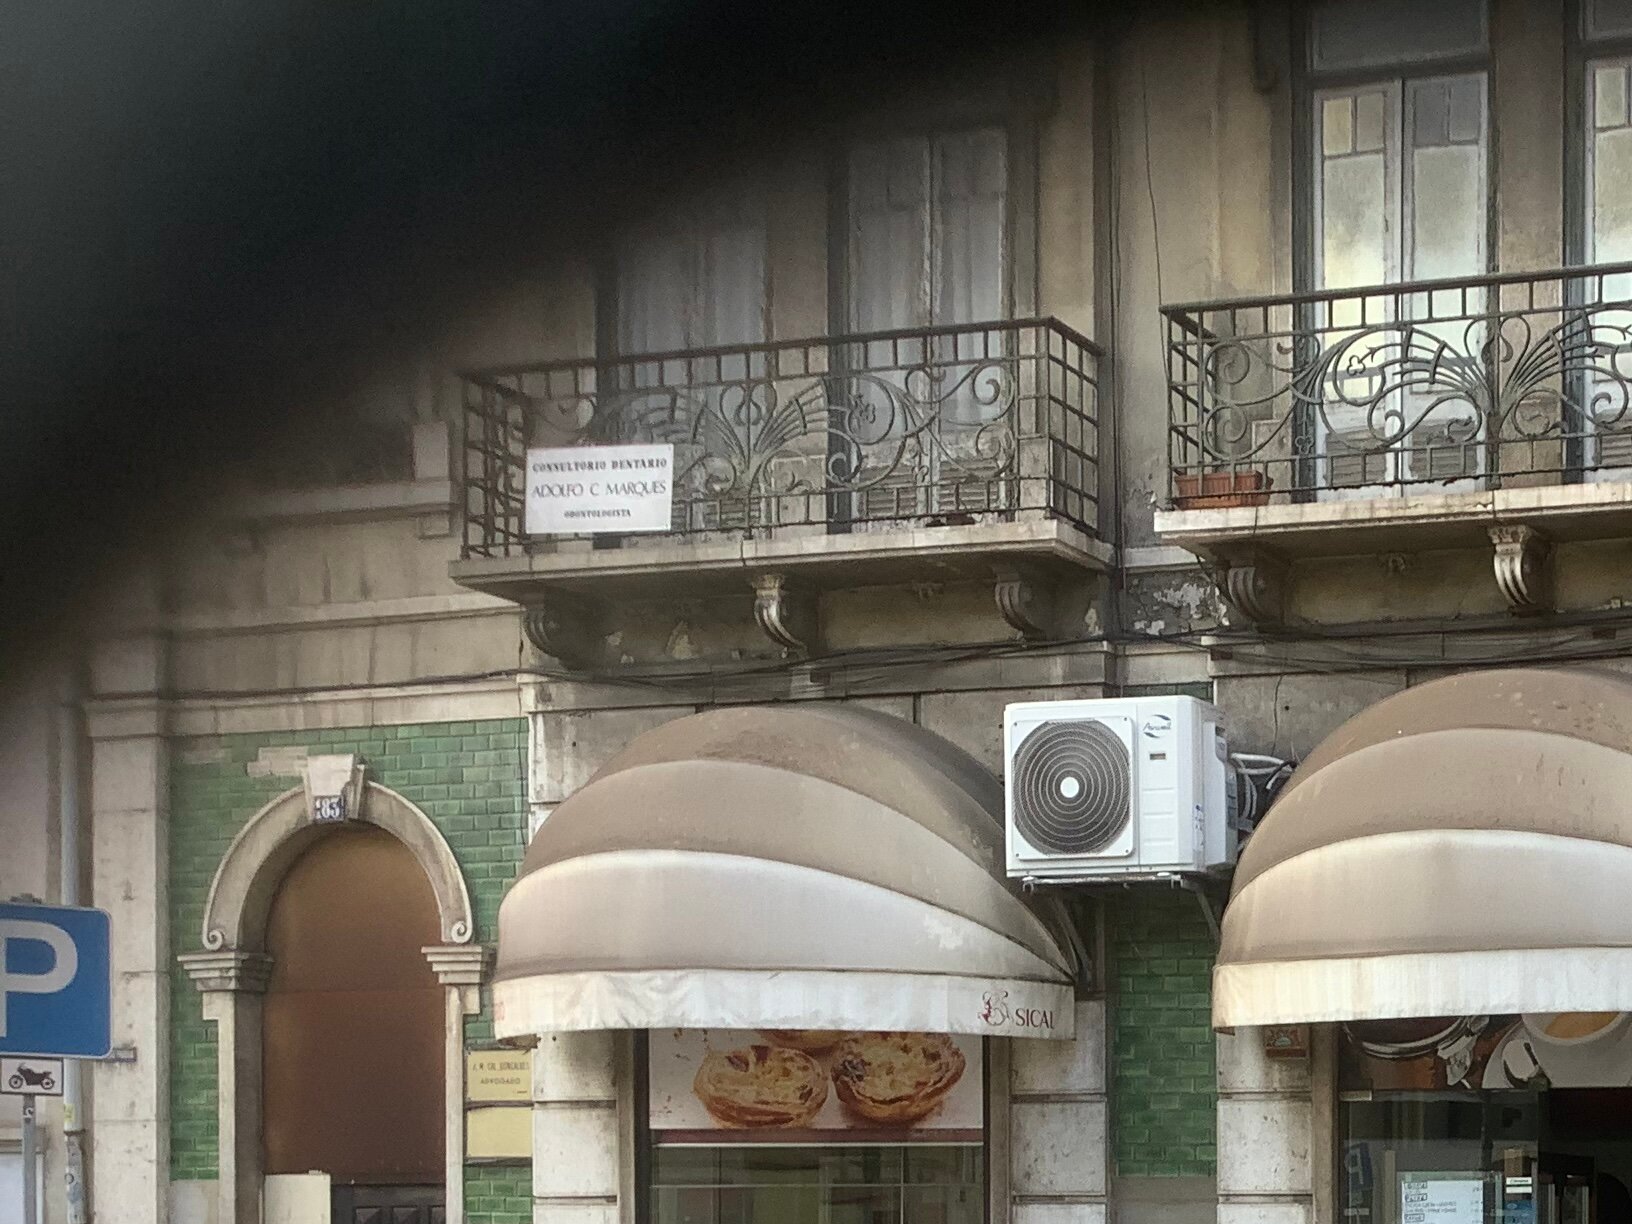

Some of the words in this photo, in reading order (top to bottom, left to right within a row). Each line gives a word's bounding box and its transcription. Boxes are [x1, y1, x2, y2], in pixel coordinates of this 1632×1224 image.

[533, 482, 584, 498] ADOLFO
[606, 479, 667, 497] MARQUES
[563, 509, 632, 518] ODONTOLOGISTA
[1015, 1007, 1055, 1030] SICAL
